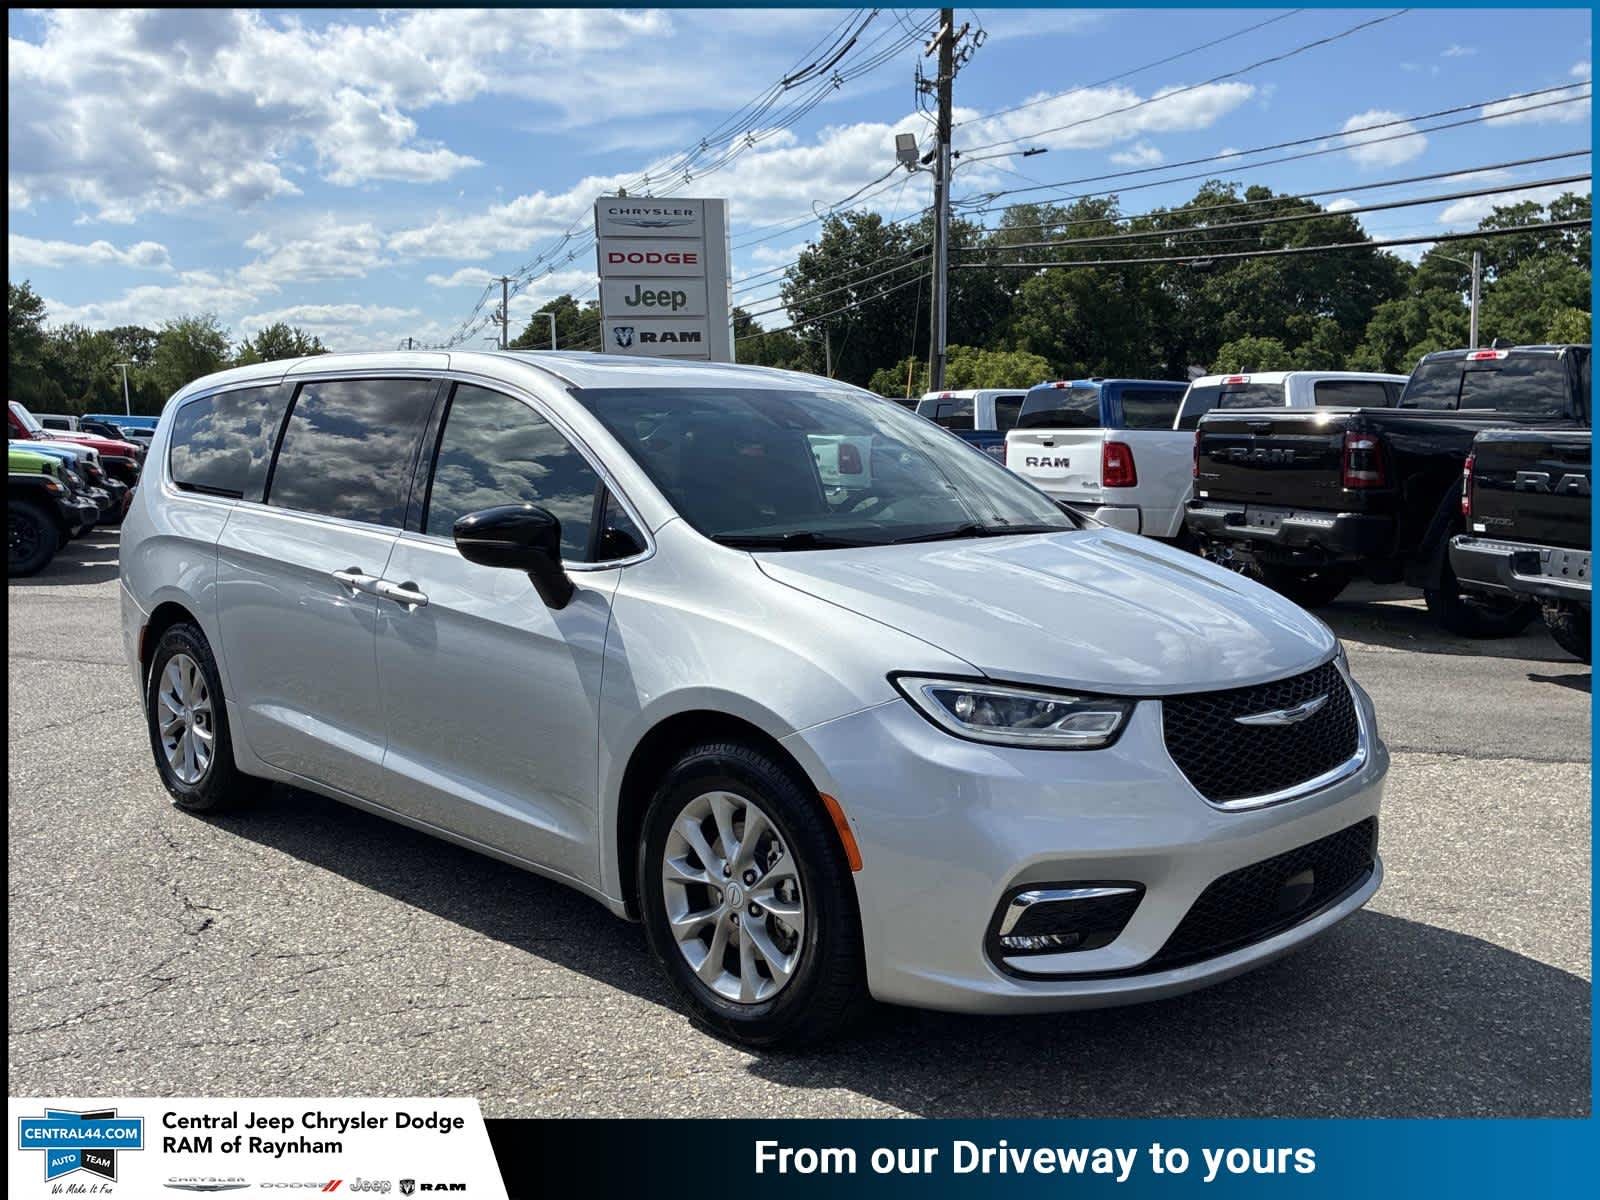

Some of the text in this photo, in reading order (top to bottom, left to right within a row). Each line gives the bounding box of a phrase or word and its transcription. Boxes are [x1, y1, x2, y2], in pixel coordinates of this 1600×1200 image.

[608, 207, 694, 217] CHRYSLER
[608, 252, 698, 265] DODGE
[624, 284, 688, 312] Jeep
[639, 331, 702, 343] RAM
[1025, 456, 1071, 468] RAM
